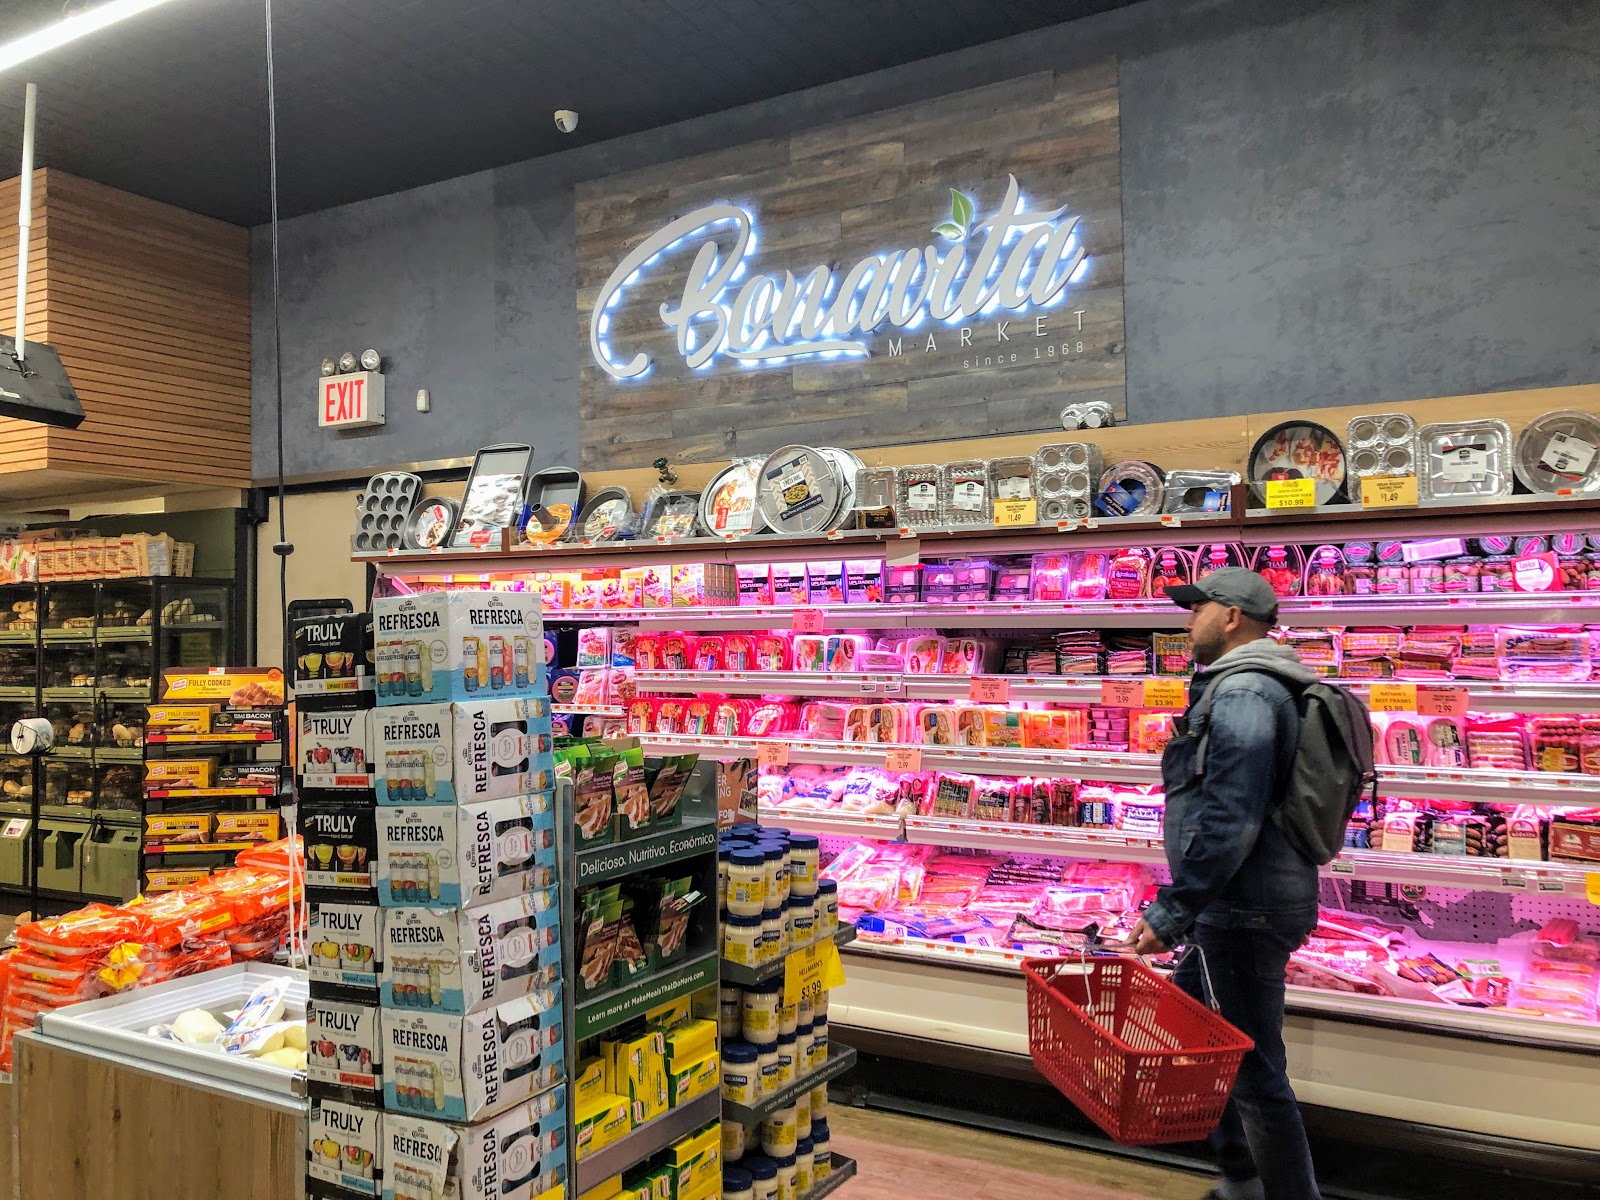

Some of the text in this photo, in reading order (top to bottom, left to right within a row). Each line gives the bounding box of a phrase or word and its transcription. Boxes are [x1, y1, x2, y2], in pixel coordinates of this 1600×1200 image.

[590, 173, 1086, 378] Bonavita
[888, 310, 1086, 358] MARKET
[962, 341, 1085, 369] since 1968
[325, 379, 364, 422] EXIT
[1279, 499, 1304, 507] $10.99
[1381, 493, 1398, 502] $1.49
[1008, 514, 1021, 522] $1.49
[379, 611, 440, 631] REFRESCA
[469, 609, 524, 625] REFRESCA
[305, 622, 344, 642] TRULY
[1436, 705, 1452, 713] $2.99
[312, 718, 353, 735] TRULY
[384, 723, 440, 740] REFRESCA
[473, 710, 486, 793] REFRESCA
[315, 815, 357, 833] TRULY
[387, 826, 444, 841] REFRESCA
[476, 811, 492, 896] REFRESCA
[580, 833, 716, 877] Delicioso. Nutritivo. Económico.
[321, 912, 363, 931] TRULY
[390, 926, 444, 943] REFRESCA
[478, 914, 494, 1000] REFRESCA
[799, 961, 823, 976] HELLMANN'S
[588, 970, 705, 1024] Learn more at MakeMealsThatDoMore.com
[801, 980, 822, 1000] $3.99
[318, 1010, 360, 1032] TRULY
[393, 1028, 448, 1052] REFRESCA
[483, 1017, 498, 1107] REFRESCA
[322, 1108, 364, 1133] TRULY
[483, 1128, 497, 1200] FRESCA
